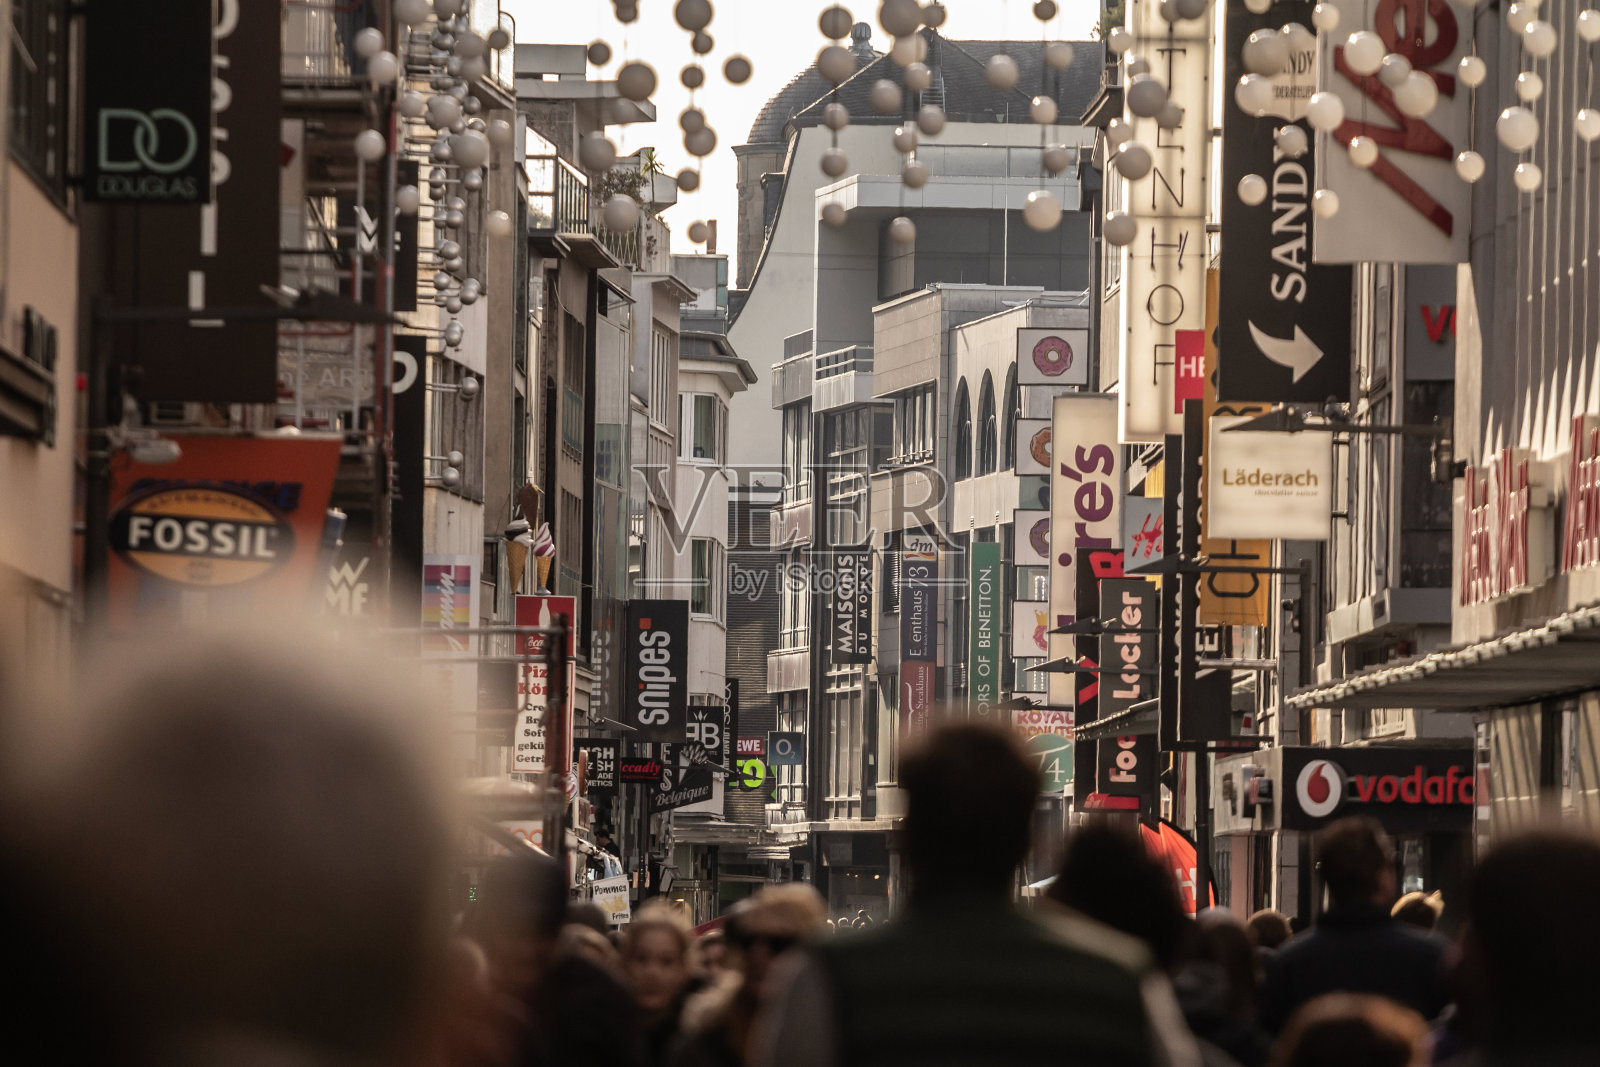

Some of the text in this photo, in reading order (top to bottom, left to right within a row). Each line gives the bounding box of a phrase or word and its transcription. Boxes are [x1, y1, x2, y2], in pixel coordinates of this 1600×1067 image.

[100, 176, 197, 197] DOUGLAS
[1270, 127, 1308, 302] SANDY
[1222, 468, 1319, 487] Läderach
[128, 516, 276, 558] FOSSIL
[910, 538, 933, 551] dm
[837, 554, 854, 654] MAISONS
[978, 564, 992, 649] BENETTON.
[527, 636, 544, 649] Coca
[1112, 590, 1142, 699] Locker
[522, 666, 547, 678] Piz
[977, 655, 991, 677] OF
[637, 630, 677, 726] snipes
[1017, 710, 1074, 725] ROYAL
[736, 739, 761, 752] EWE
[655, 785, 710, 807] Belgique
[1356, 766, 1474, 804] vodafo
[594, 884, 627, 896] Pommes
